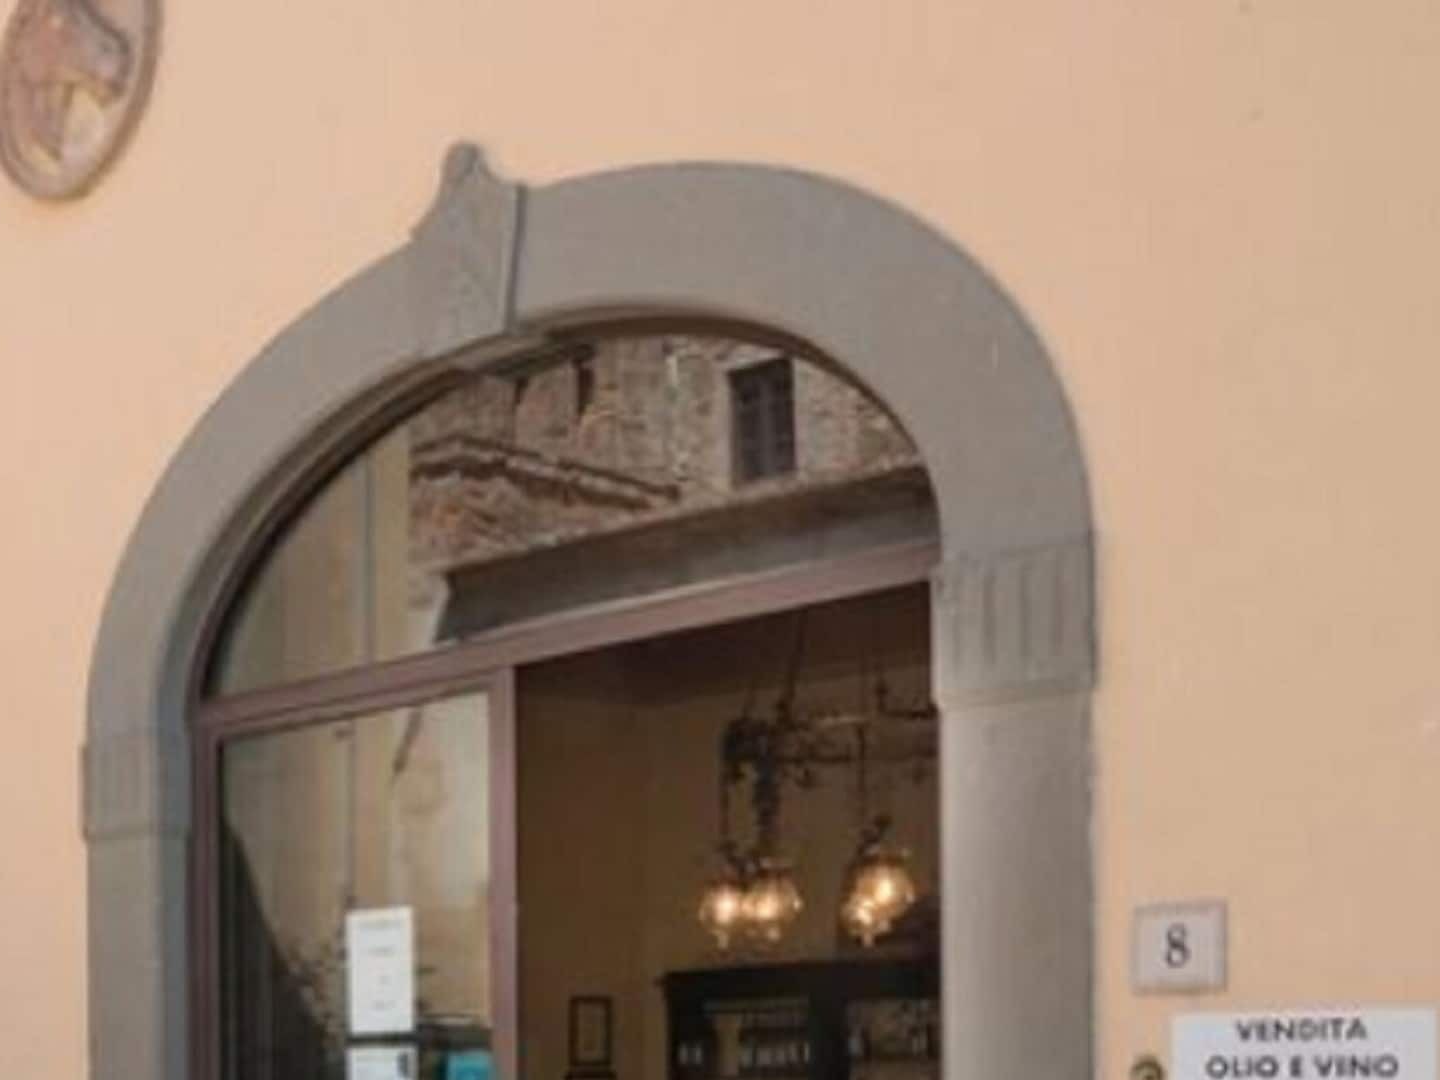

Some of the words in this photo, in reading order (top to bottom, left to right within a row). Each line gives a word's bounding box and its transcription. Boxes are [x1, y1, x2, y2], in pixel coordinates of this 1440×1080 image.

[1164, 921, 1190, 968] 8
[1235, 1017, 1367, 1042] VENDITA
[1206, 1054, 1279, 1079] OLIO
[1290, 1056, 1303, 1078] E
[1314, 1054, 1399, 1078] VINO
